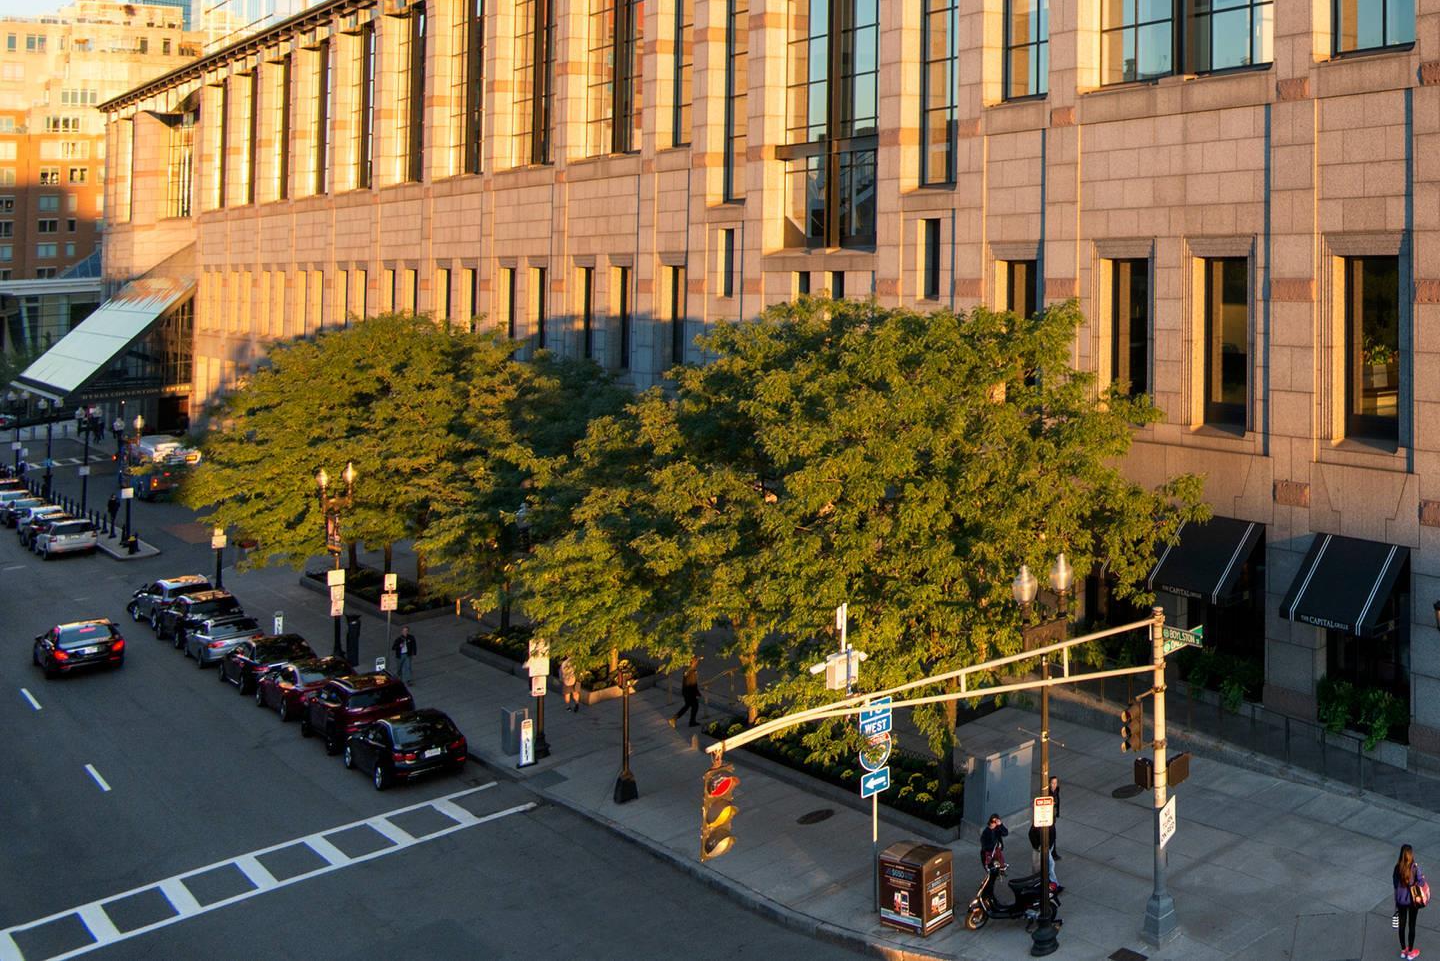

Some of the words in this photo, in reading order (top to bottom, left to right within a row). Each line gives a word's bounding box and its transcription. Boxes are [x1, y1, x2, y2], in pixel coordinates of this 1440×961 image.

[161, 385, 190, 393] CENTER
[1309, 616, 1335, 629] CAPITAL
[1170, 629, 1195, 644] BOYLSTON
[864, 719, 887, 736] WEST
